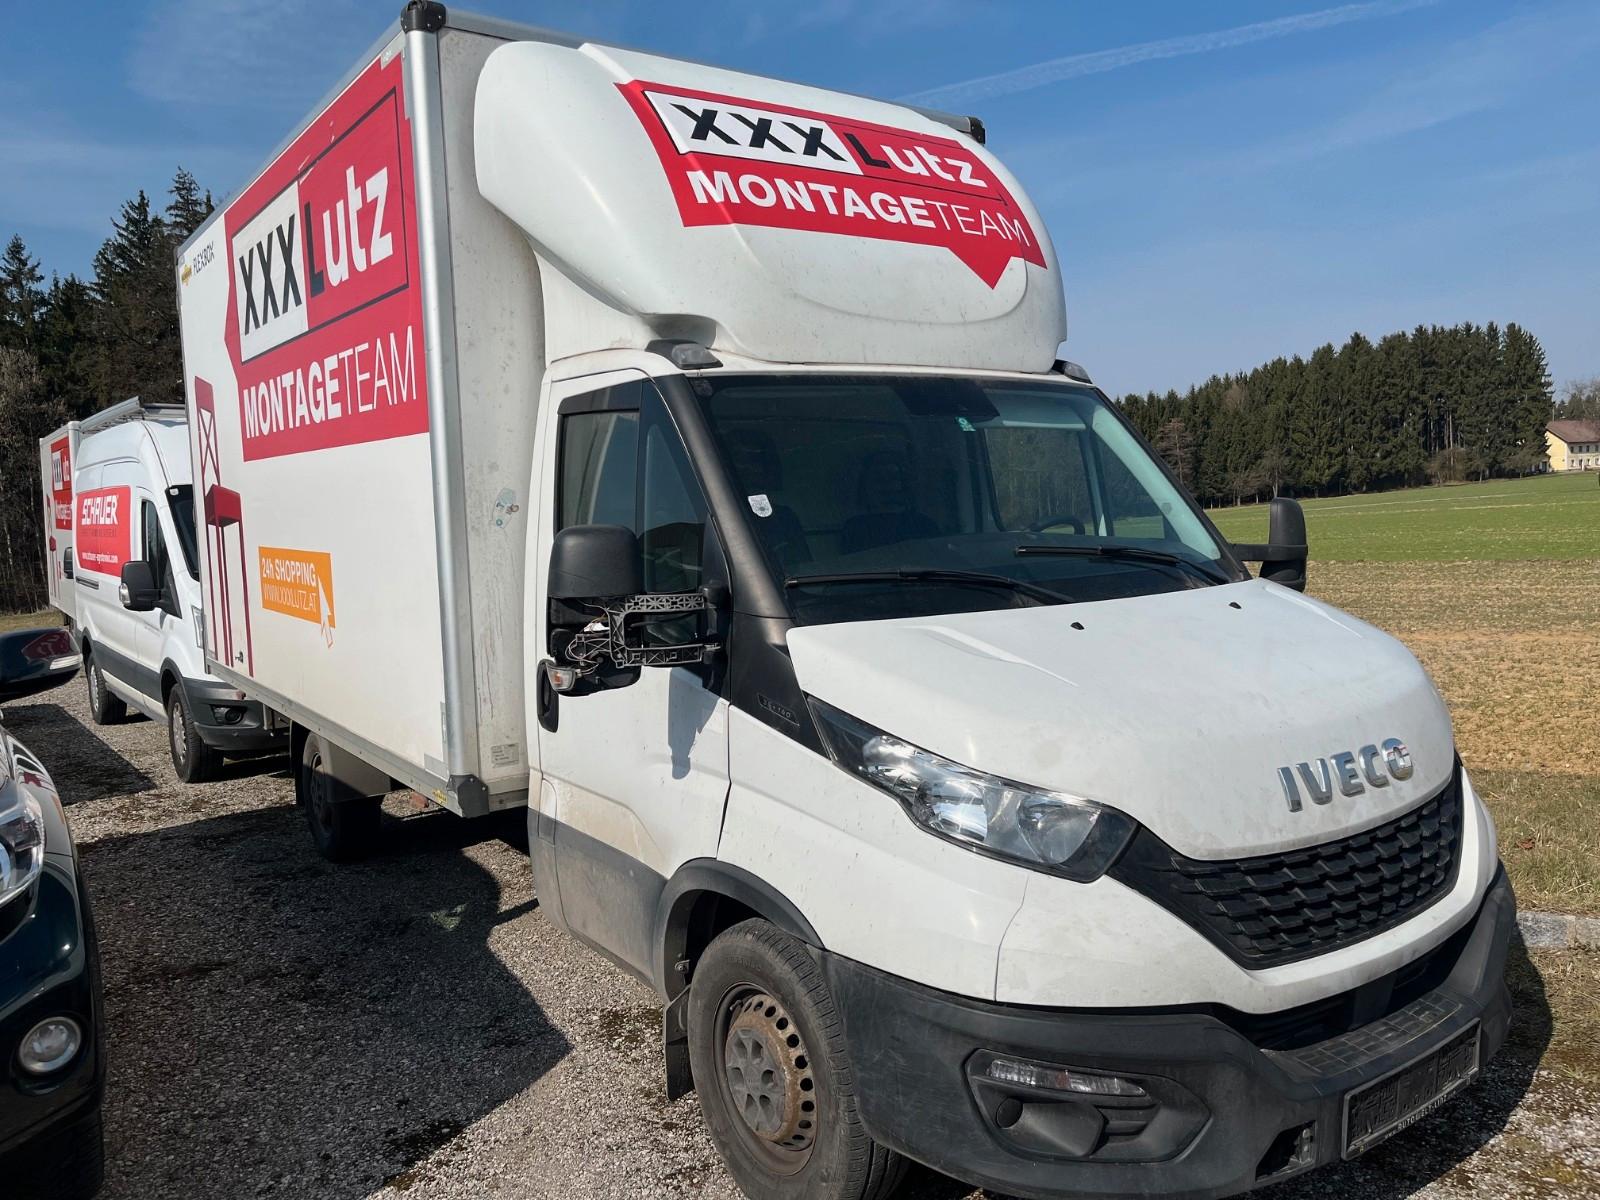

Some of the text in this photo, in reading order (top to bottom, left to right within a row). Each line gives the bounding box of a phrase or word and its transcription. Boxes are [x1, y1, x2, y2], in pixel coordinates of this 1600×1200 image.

[81, 494, 119, 526] SCHAUER
[261, 557, 317, 588] 24h SHOPPING
[1276, 737, 1414, 813] IVECO
